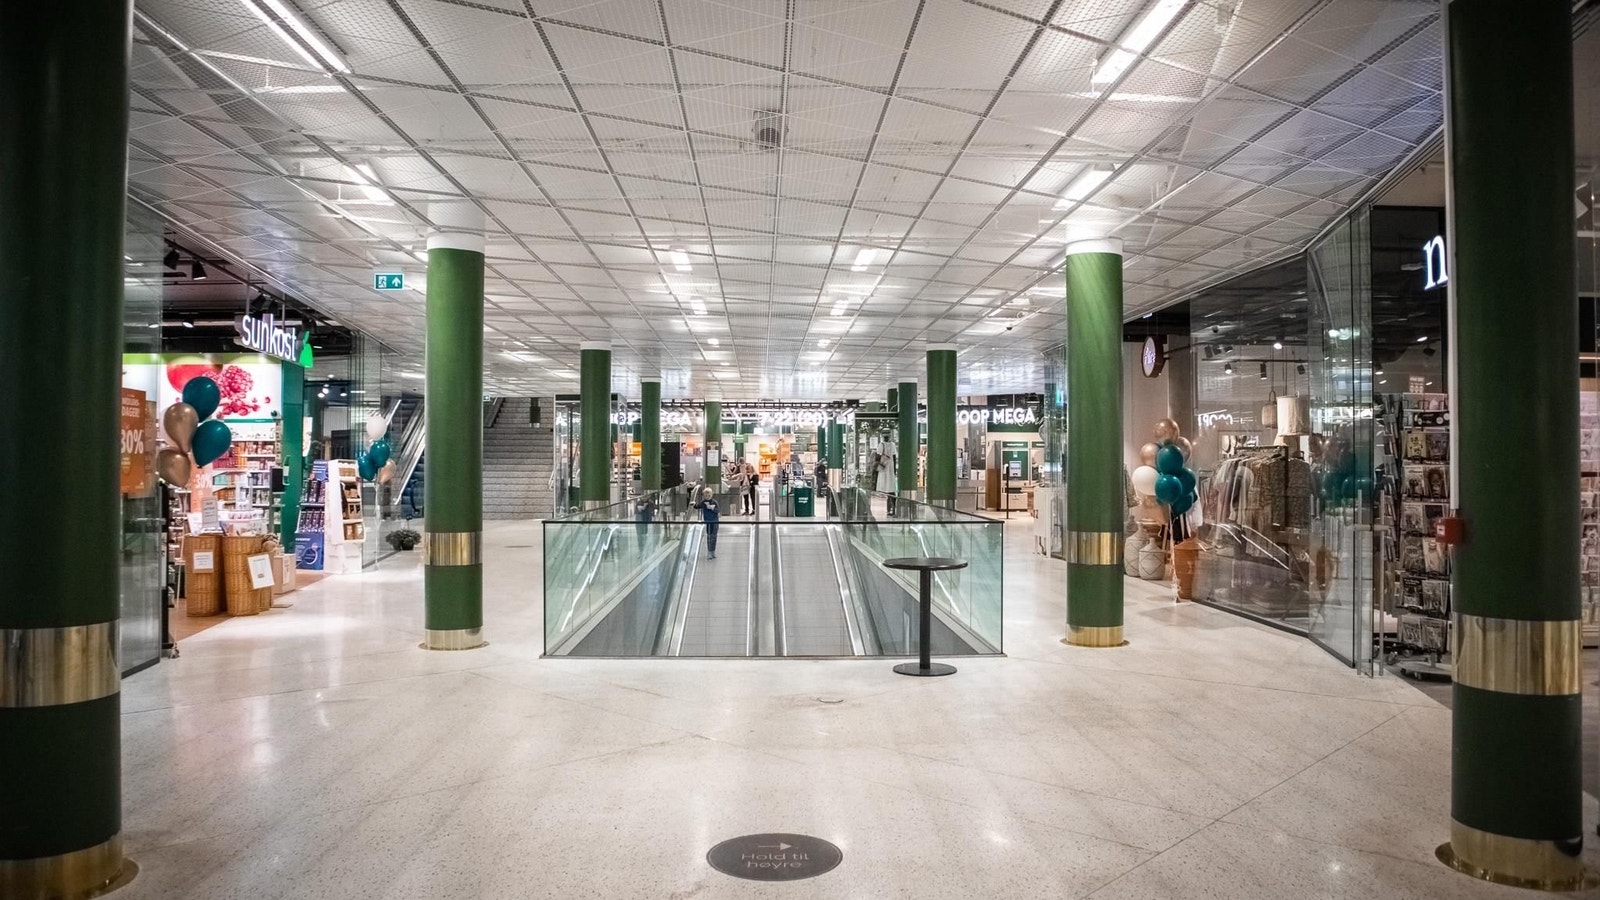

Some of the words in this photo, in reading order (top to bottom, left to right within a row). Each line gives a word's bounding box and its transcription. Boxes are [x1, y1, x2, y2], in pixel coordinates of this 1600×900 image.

[242, 313, 297, 361] sunkost
[956, 409, 990, 424] OOP
[993, 408, 1035, 424] MEGA
[120, 429, 144, 454] 30%
[747, 861, 801, 869] høyre
